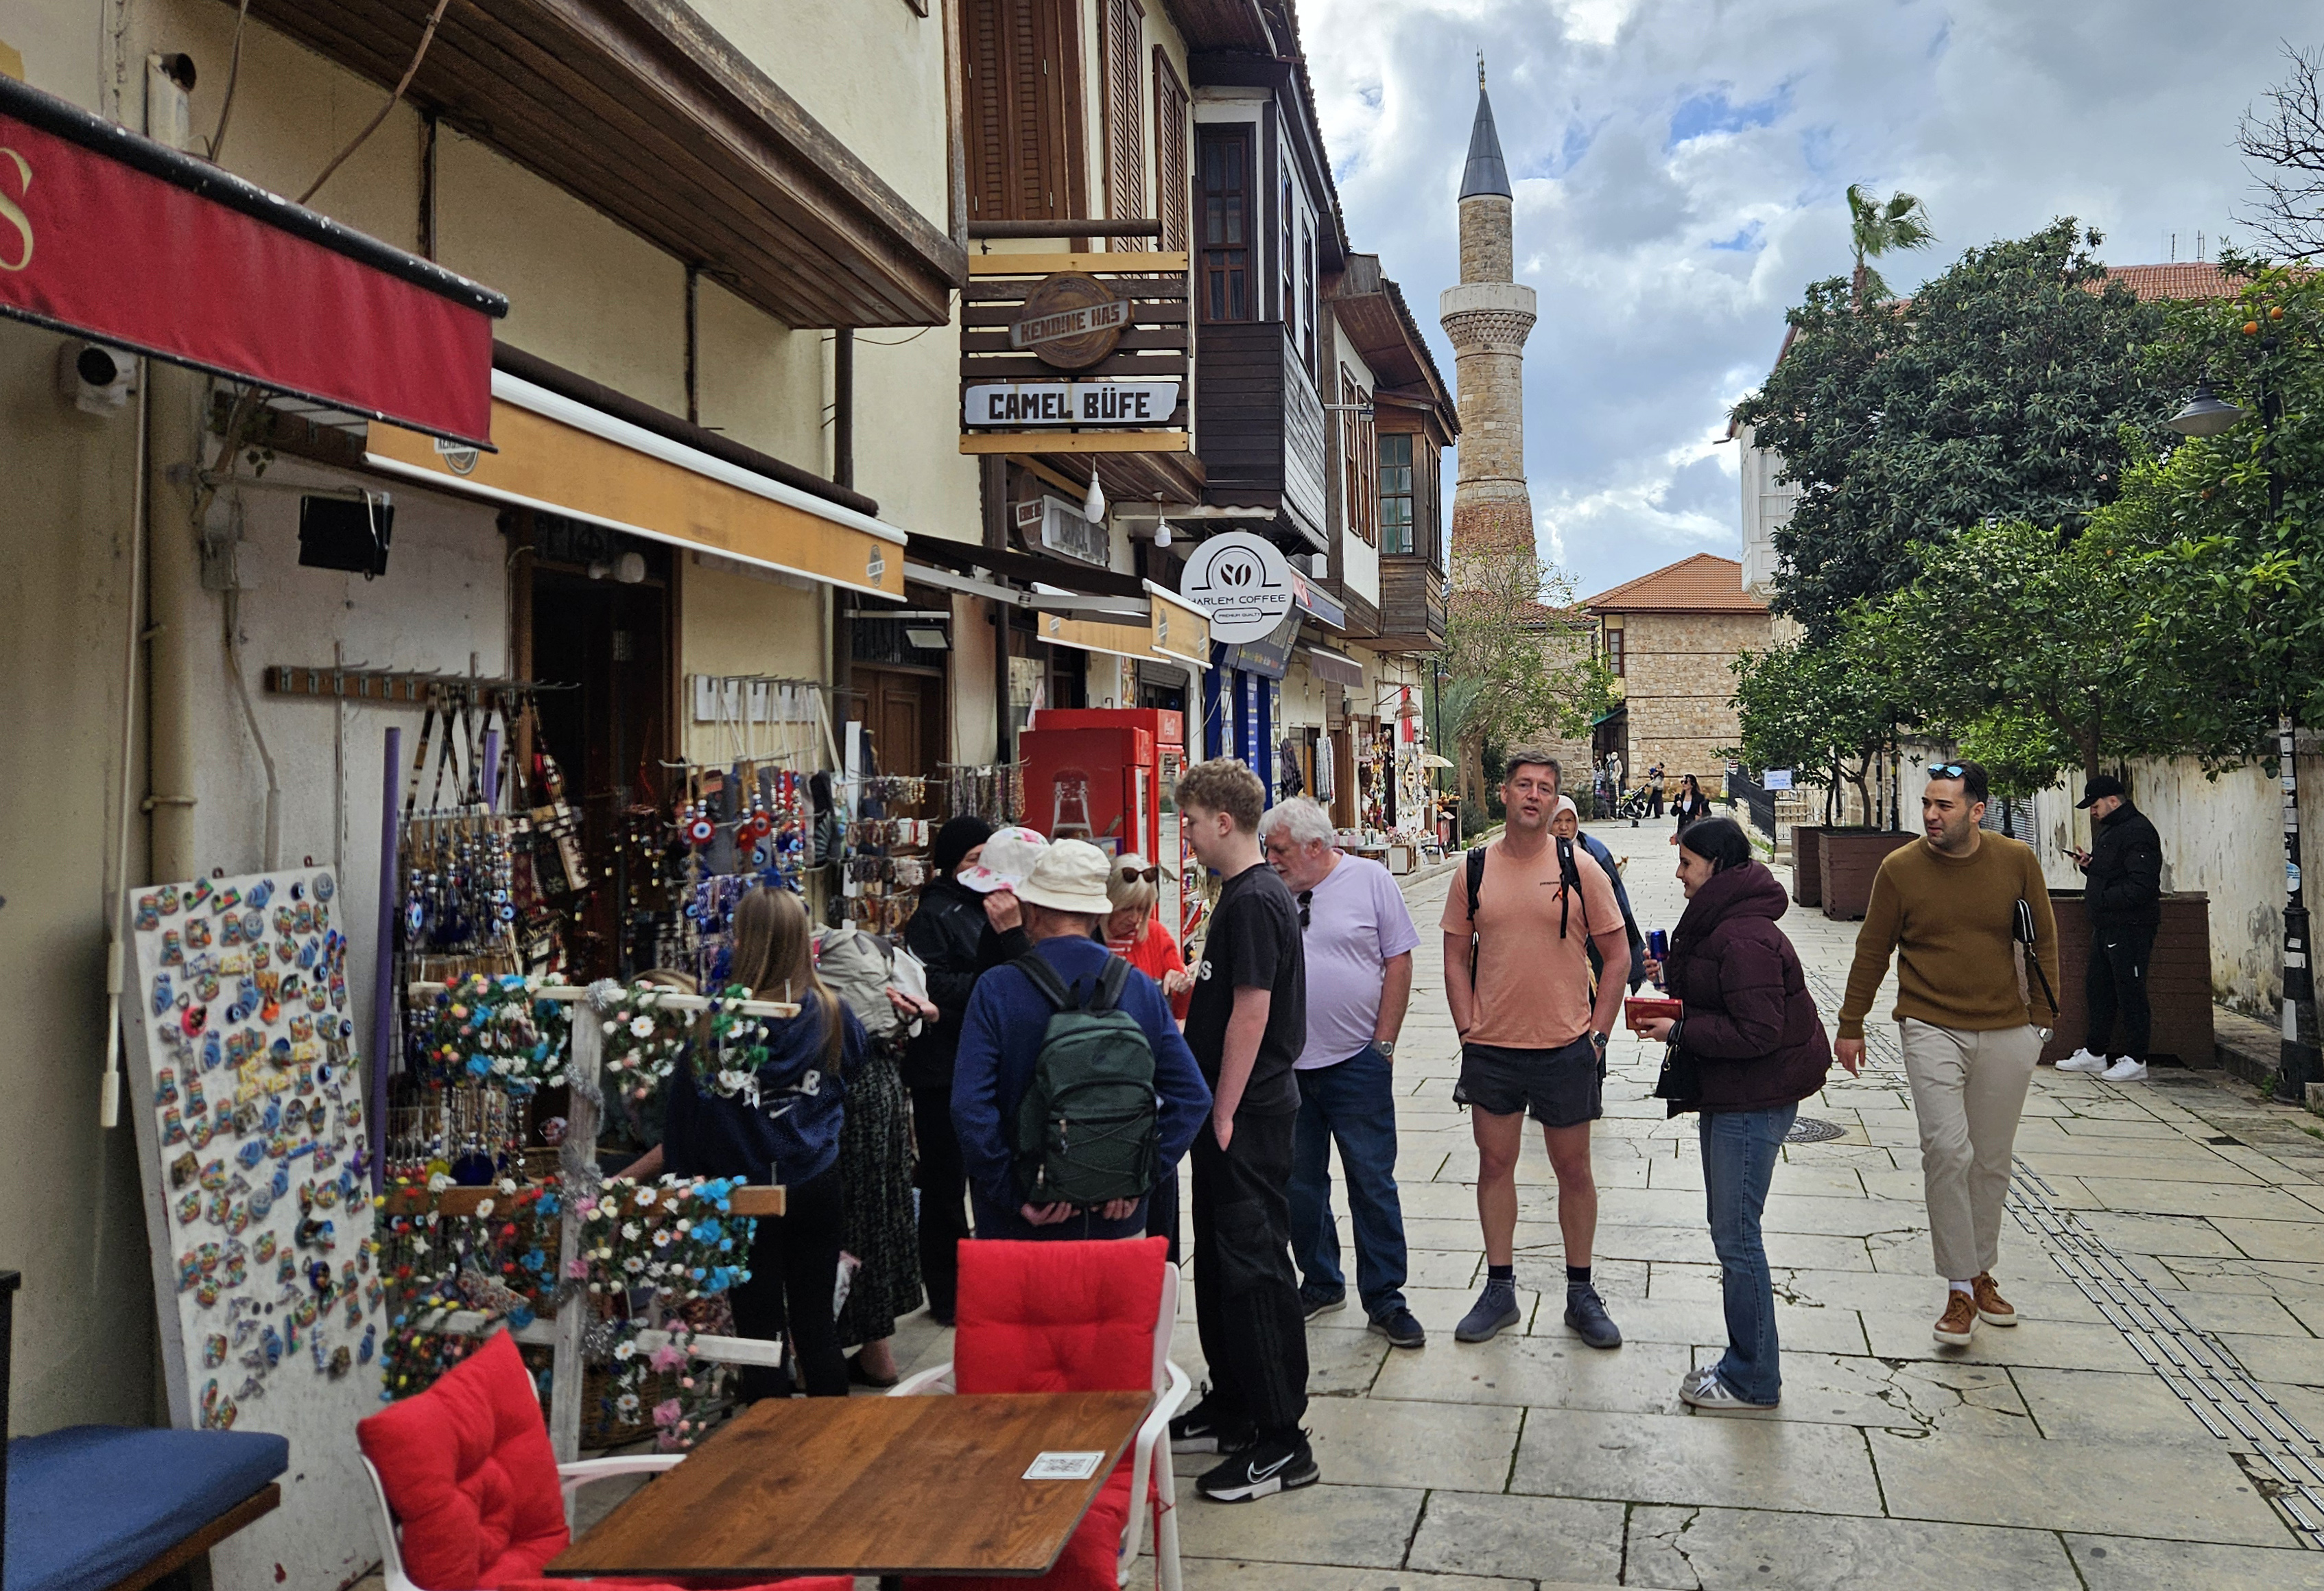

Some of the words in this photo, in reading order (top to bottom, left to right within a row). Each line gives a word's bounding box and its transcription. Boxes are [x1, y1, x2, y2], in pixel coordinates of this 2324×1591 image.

[1091, 304, 1120, 327] HAS
[989, 393, 1074, 420] CAMEL
[1084, 388, 1150, 419] BÜFE
[1239, 594, 1286, 604] COFFEE
